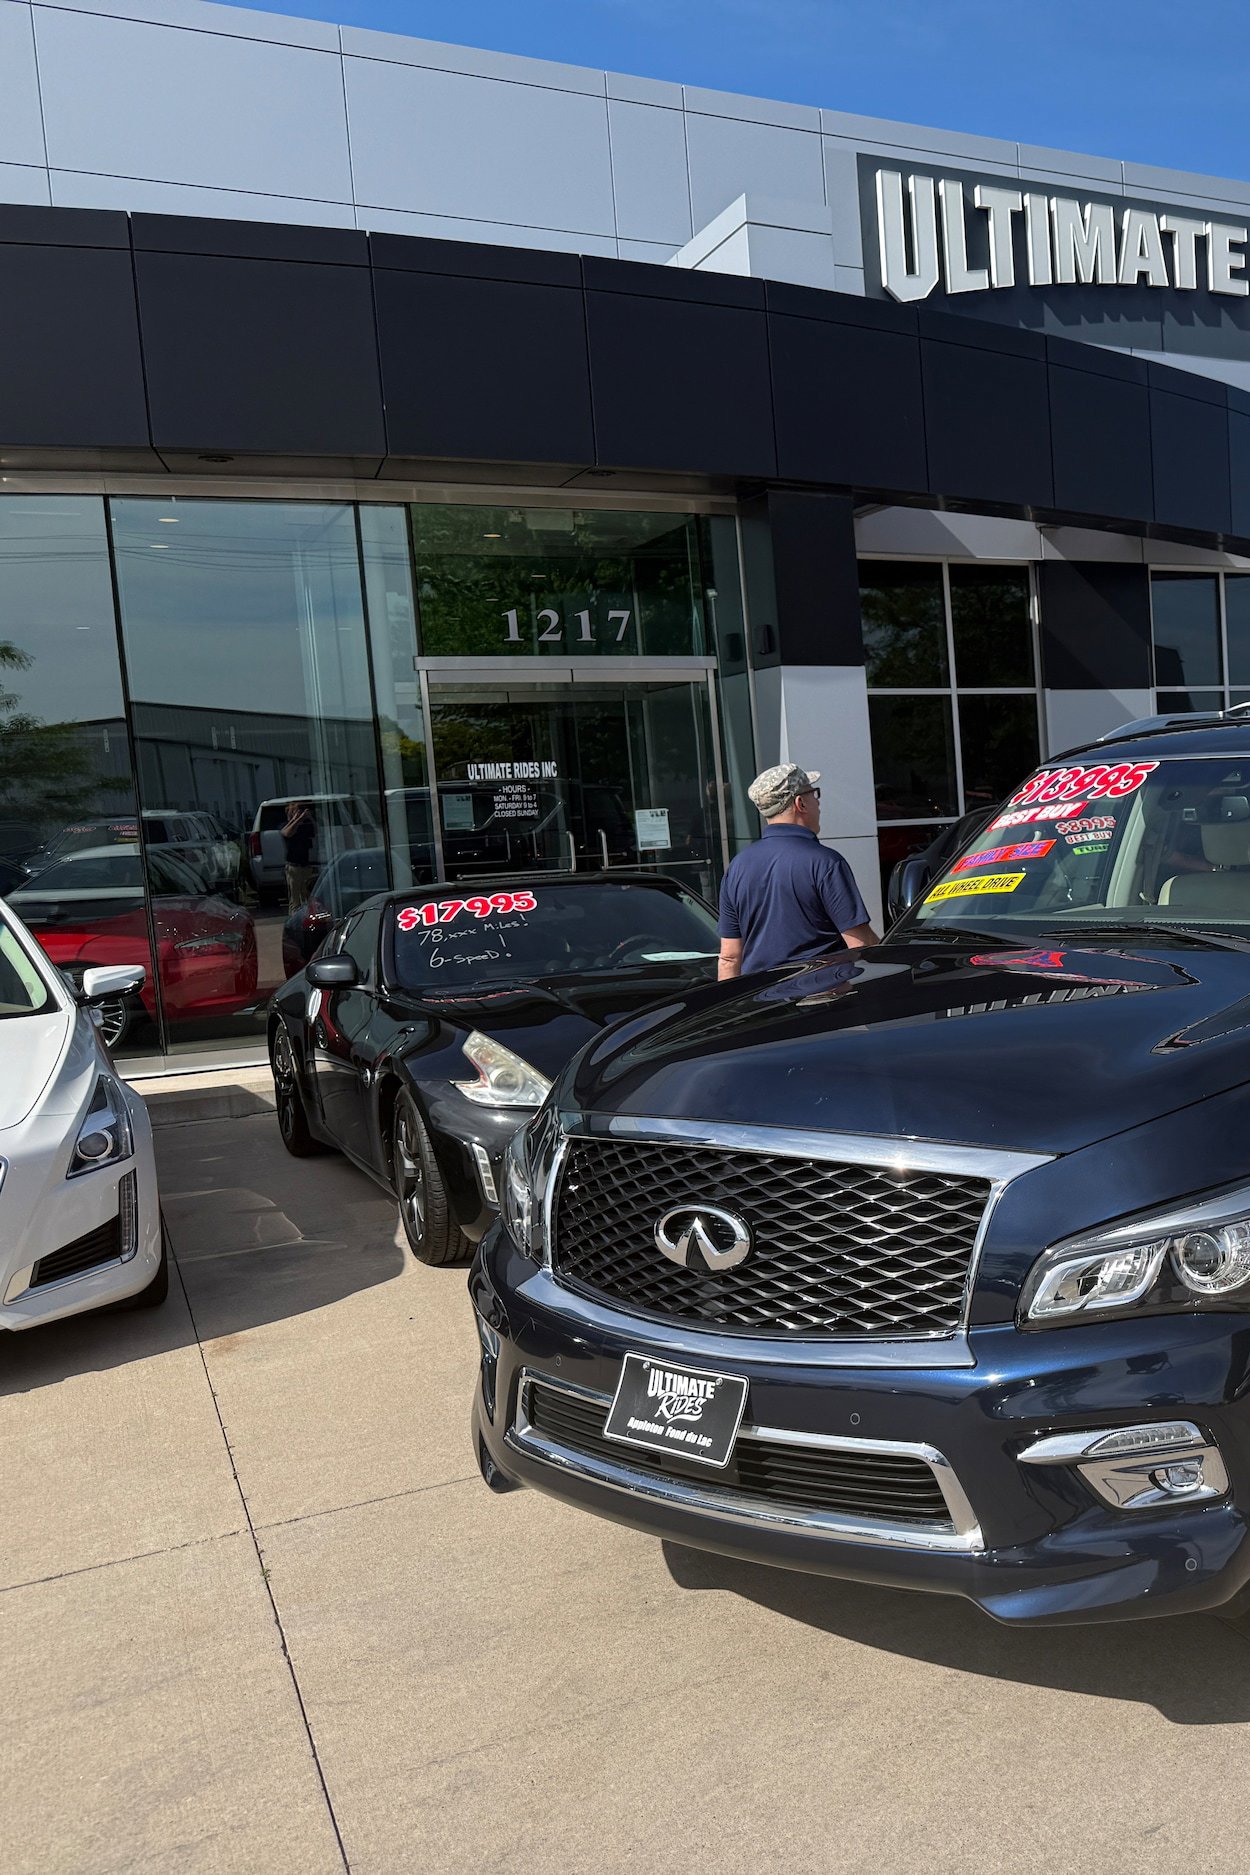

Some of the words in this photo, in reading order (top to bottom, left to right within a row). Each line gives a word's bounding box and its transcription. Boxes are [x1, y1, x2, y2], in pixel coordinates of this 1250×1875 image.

[875, 168, 1250, 302] ULTIMATE
[501, 608, 631, 642] 1217
[467, 763, 512, 780] ULTIMATE
[513, 761, 540, 779] RIDES
[541, 761, 558, 778] INC
[502, 785, 527, 794] HOURS
[1008, 761, 1160, 807] $13995
[494, 802, 522, 810] SATURDAY
[533, 793, 537, 801] 7
[494, 810, 516, 818] CLOSED
[516, 809, 539, 817] SUNDAY
[992, 806, 1041, 830] BEST
[1038, 801, 1083, 819] BUY
[1056, 816, 1116, 835] $8995
[1065, 833, 1090, 844] BEST
[1092, 831, 1113, 840] BUY
[1009, 842, 1050, 858] SIZE
[929, 885, 951, 900] ALL
[948, 879, 985, 895] WHEEL
[982, 876, 1020, 889] DRIVE
[397, 891, 537, 931] $17995
[647, 1367, 716, 1399] ULTIMATE
[626, 1416, 665, 1435] Appleton
[665, 1426, 688, 1441] Fond
[685, 1431, 699, 1444] du
[696, 1433, 713, 1448] Lac
